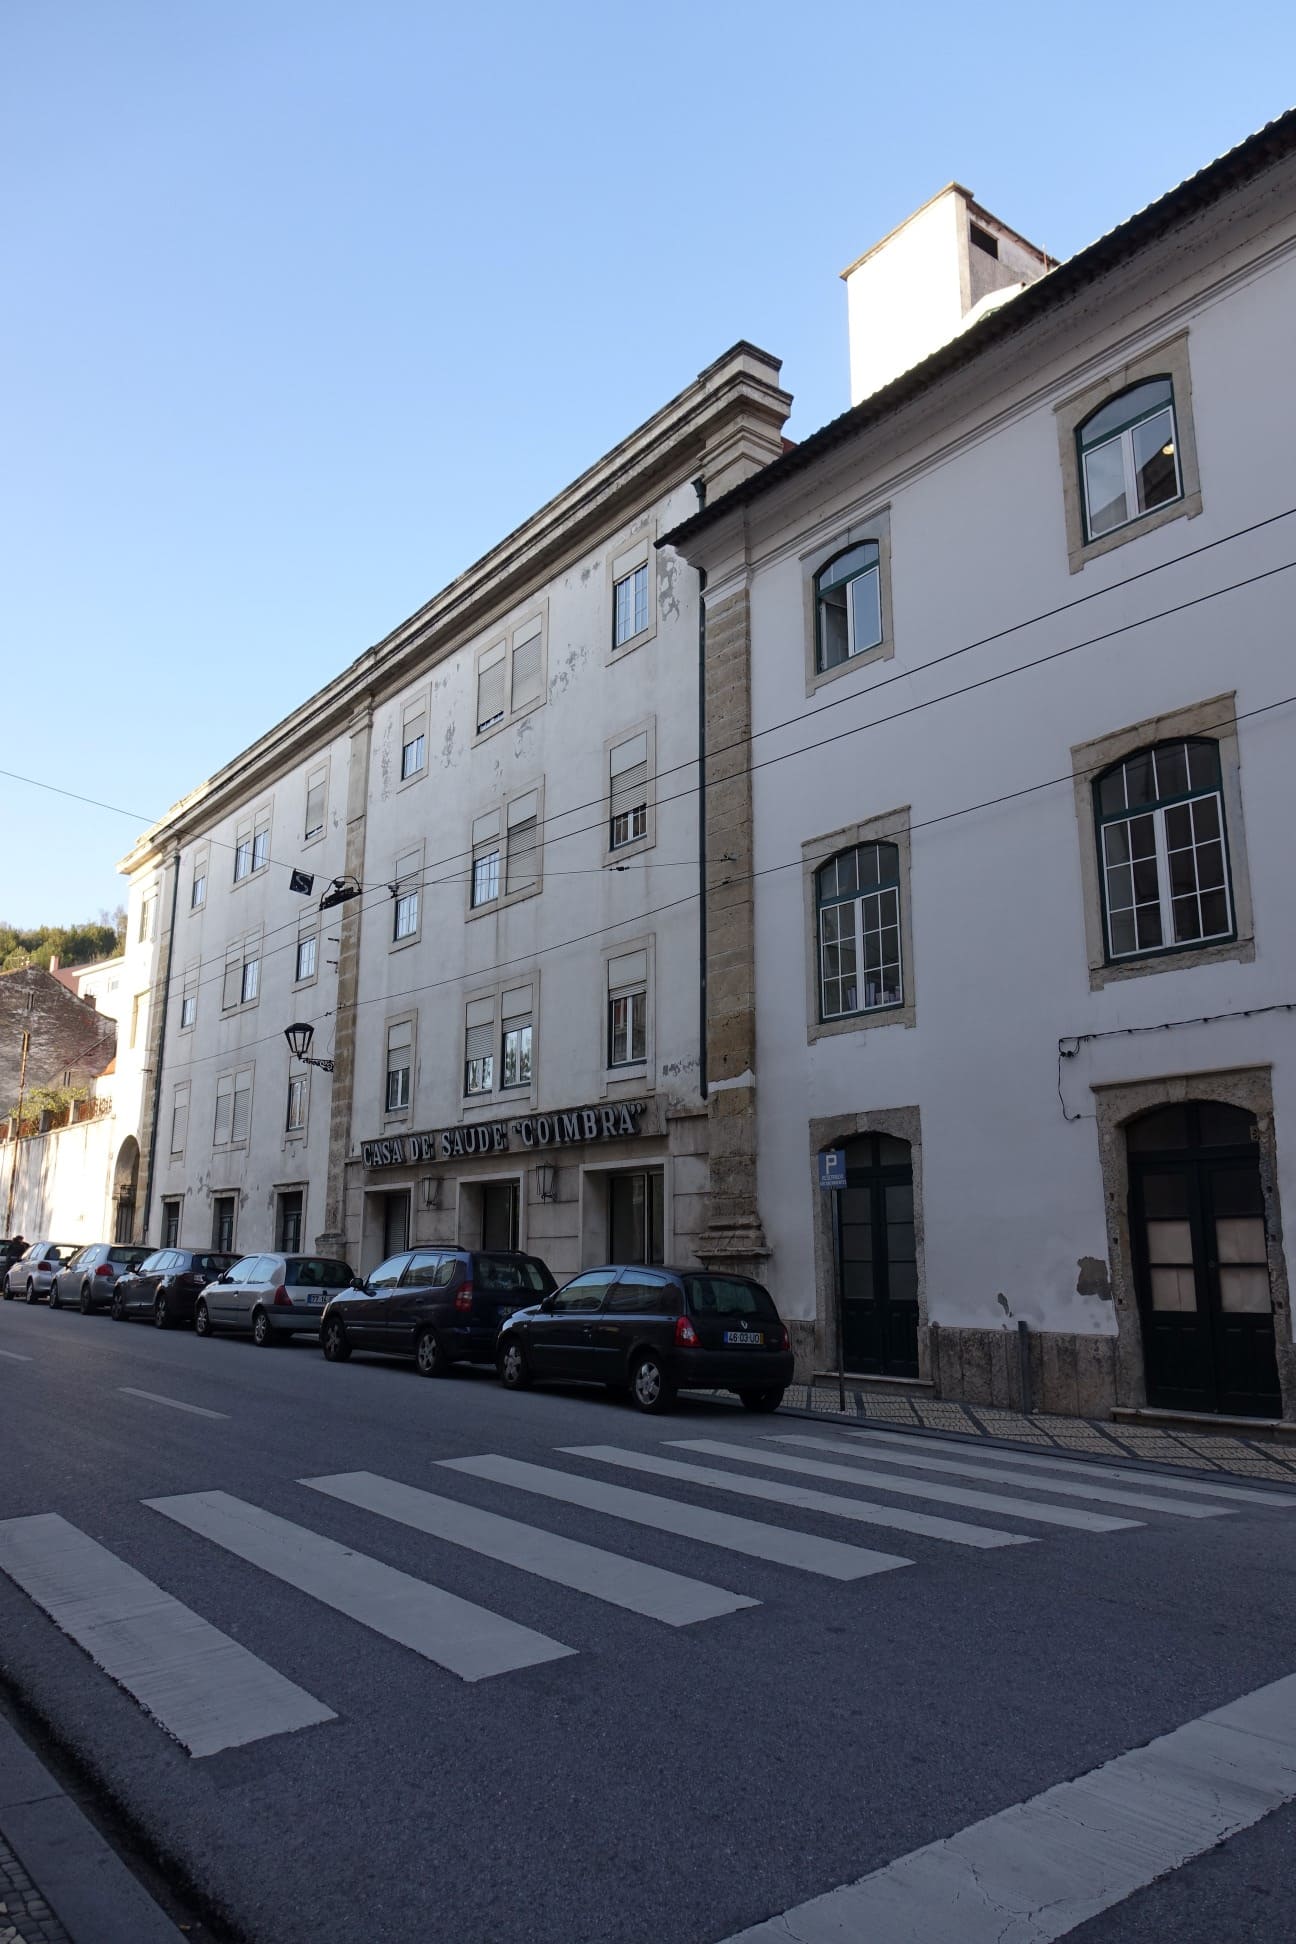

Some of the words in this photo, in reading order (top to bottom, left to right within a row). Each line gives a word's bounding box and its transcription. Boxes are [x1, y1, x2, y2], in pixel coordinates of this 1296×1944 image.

[363, 1141, 402, 1166] CASA
[410, 1135, 433, 1161] DE
[441, 1123, 506, 1157] SAUDE
[826, 1154, 837, 1175] P
